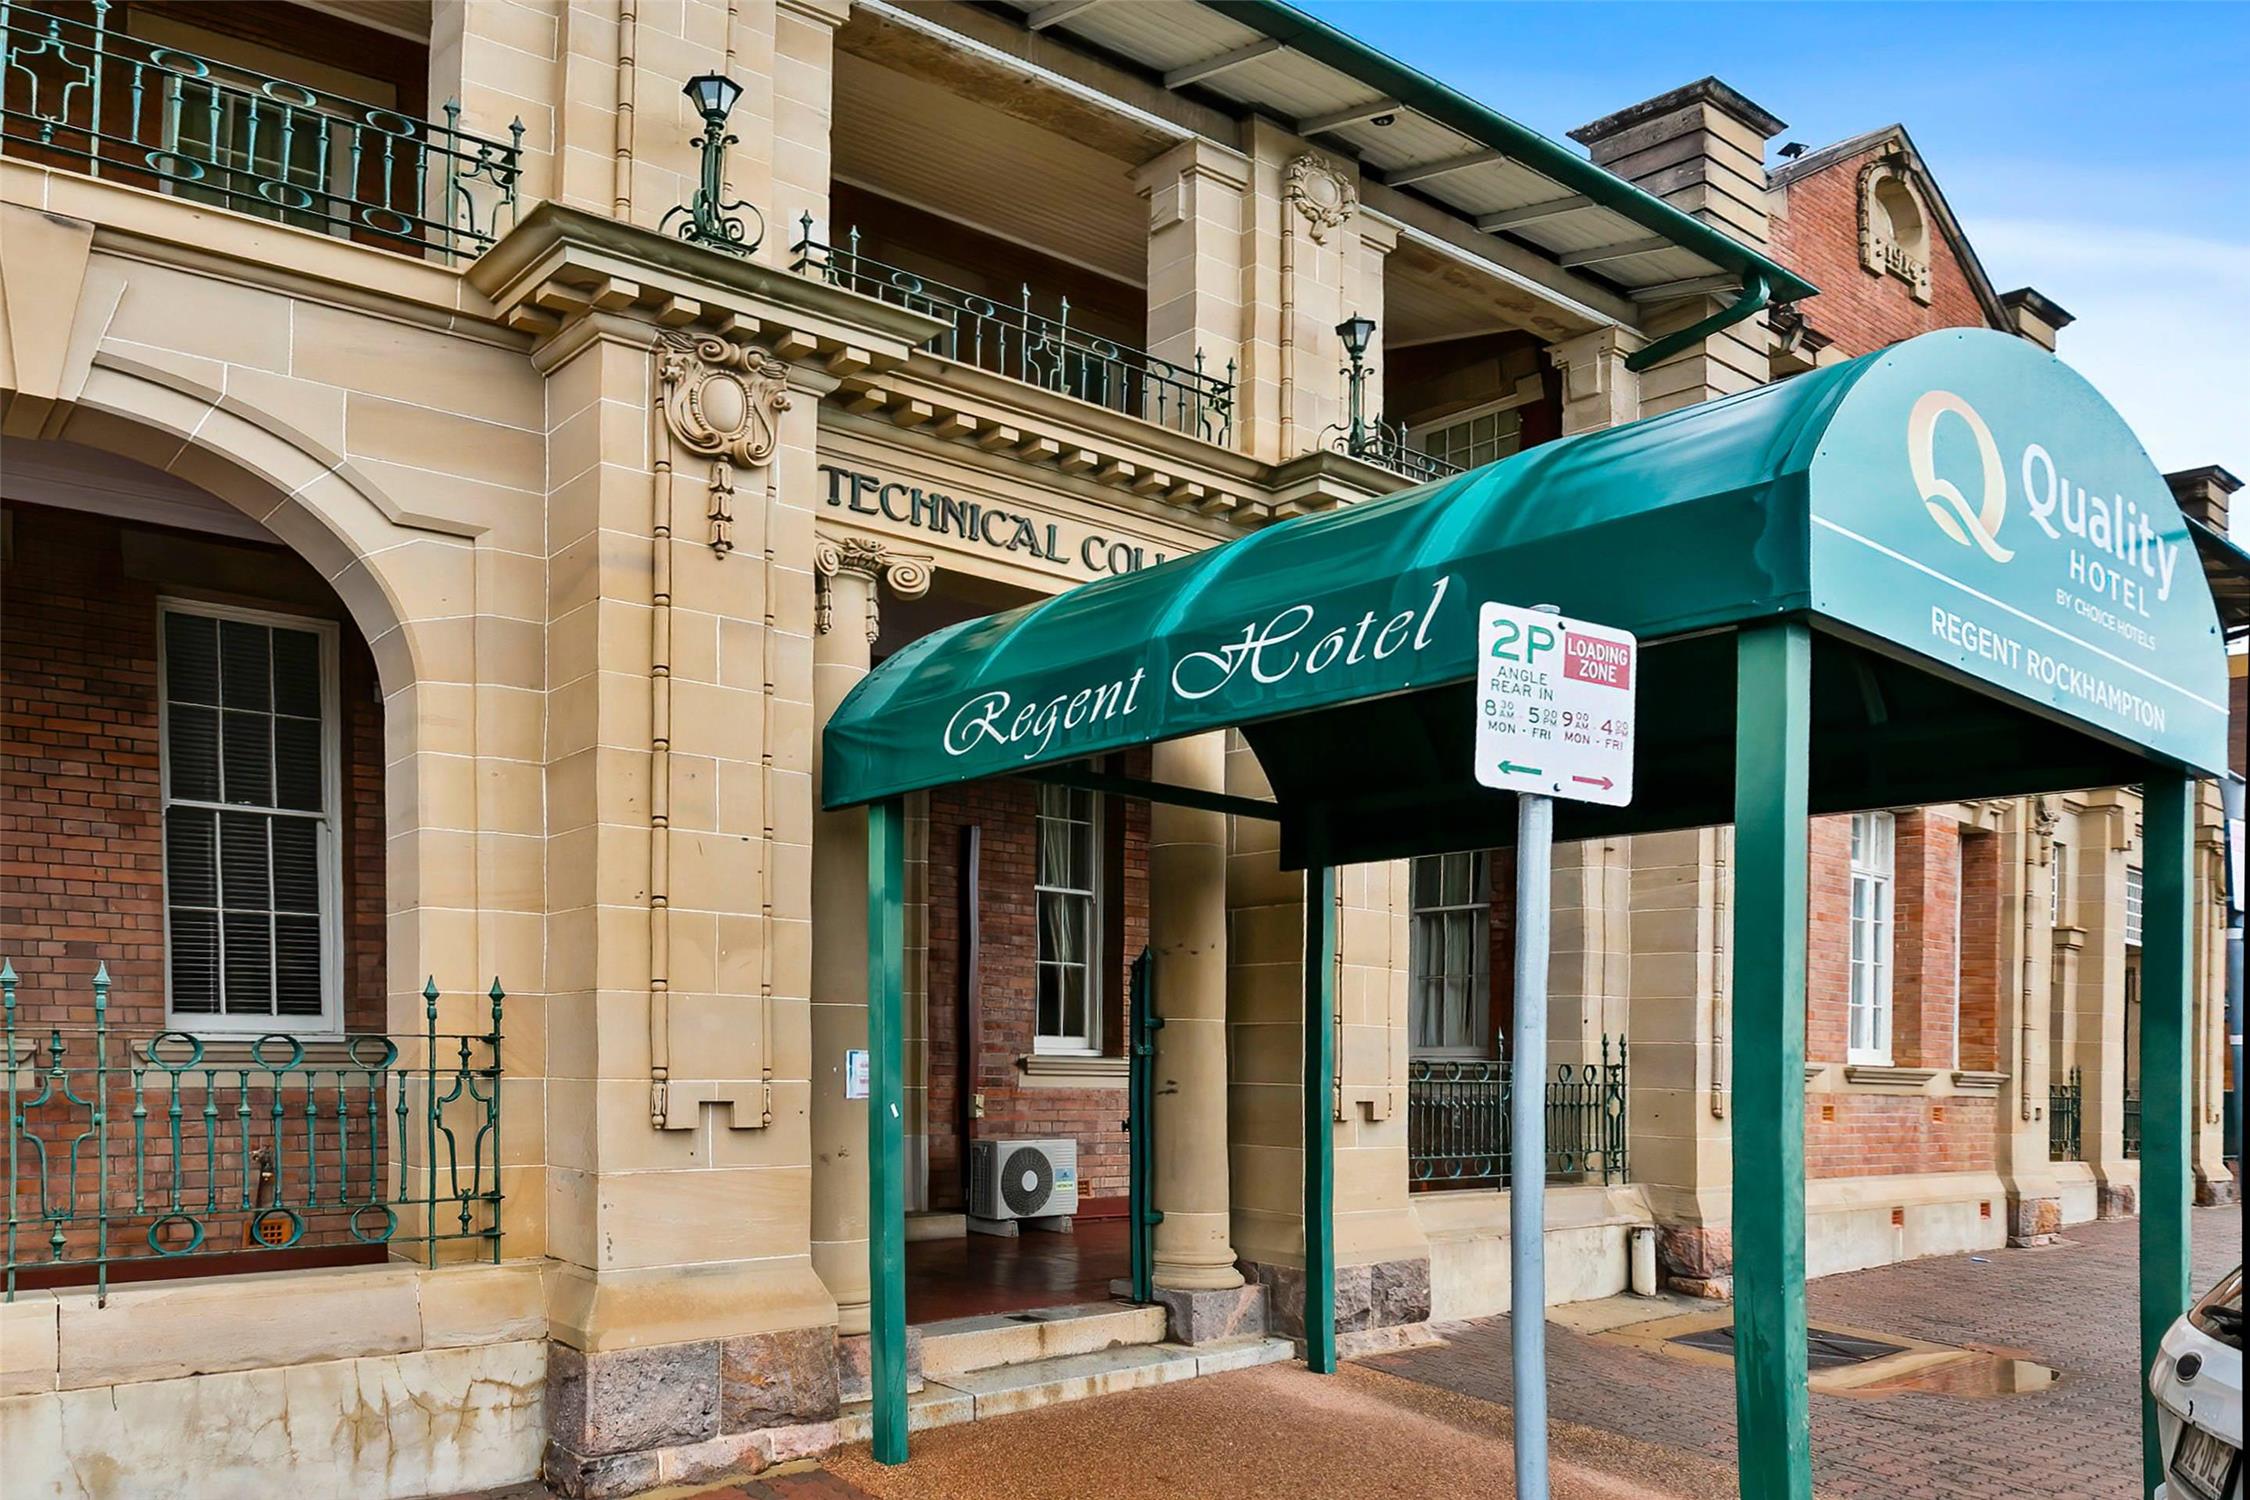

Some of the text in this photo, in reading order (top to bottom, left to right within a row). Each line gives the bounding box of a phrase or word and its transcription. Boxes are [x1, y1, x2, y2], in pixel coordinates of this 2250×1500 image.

[817, 464, 1071, 564] TECHNICAL
[2021, 443, 2179, 602] Quality
[2070, 549, 2150, 618] HOTEL
[1491, 619, 1555, 664] 2P
[2056, 588, 2156, 651] BY CHOICE HOTELS
[943, 576, 1450, 760] Regent Hotel
[1567, 637, 1628, 666] LOADING
[1579, 659, 1617, 683] ZONE
[1931, 605, 2166, 733] REGENT ROCKHAMPTON
[1491, 678, 1553, 701] REAR IN
[1498, 665, 1548, 686] ANGLE
[1487, 721, 1517, 735] MON
[1532, 727, 1551, 740] FRI
[1564, 731, 1591, 744] MON
[1605, 738, 1624, 750] FRI
